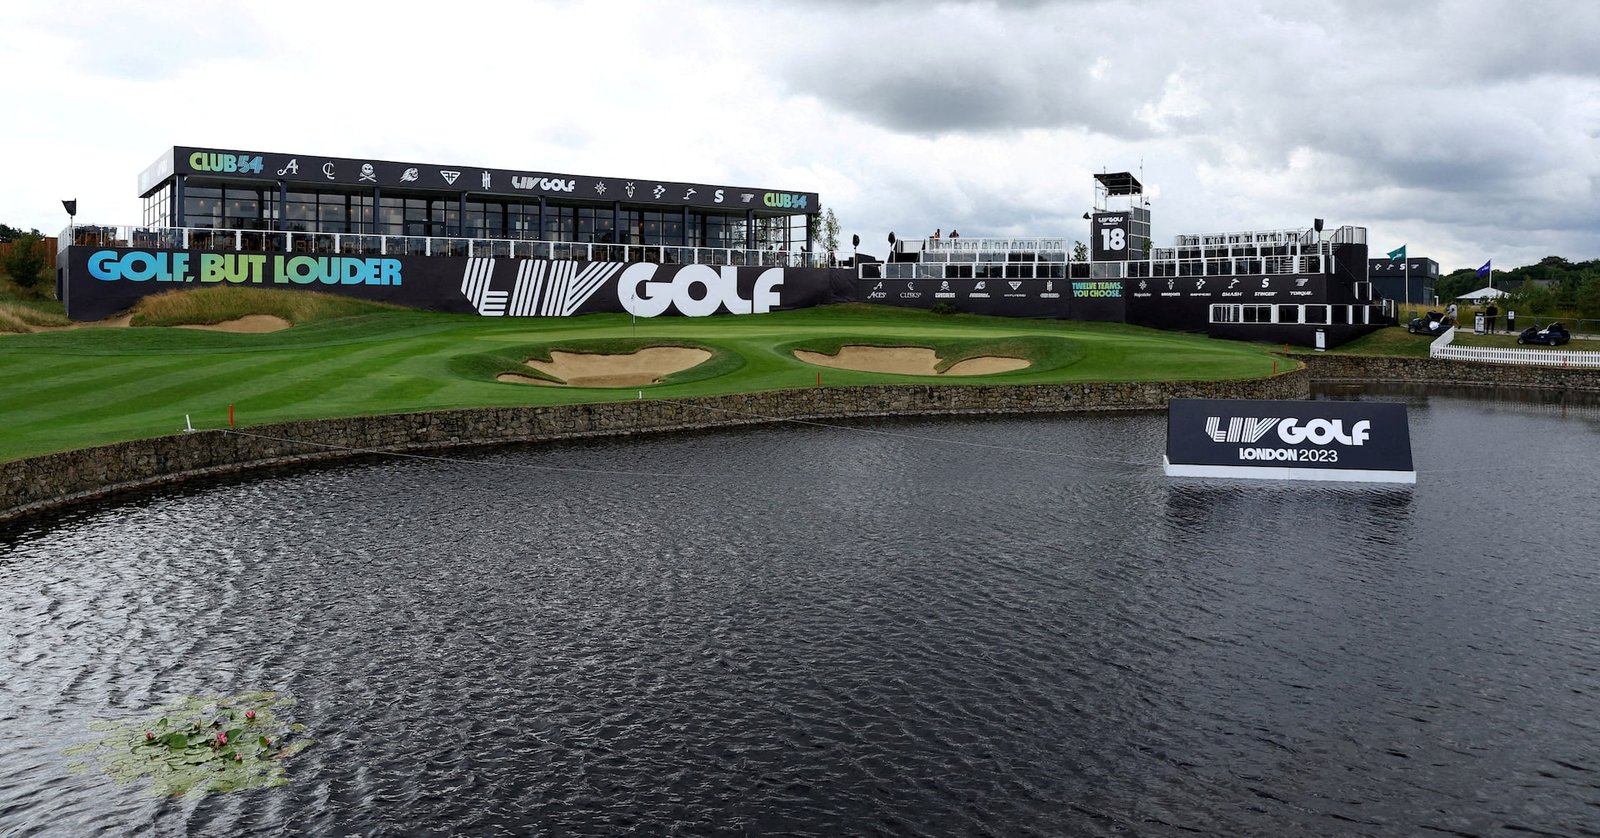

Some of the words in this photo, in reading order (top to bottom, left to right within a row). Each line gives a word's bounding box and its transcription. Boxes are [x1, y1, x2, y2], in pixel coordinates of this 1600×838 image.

[1101, 227, 1126, 251] 18
[87, 250, 195, 283] GOLF,
[200, 253, 266, 284] BUT
[274, 255, 402, 287] LOUDER
[617, 261, 785, 318] GOLF
[1072, 282, 1097, 290] TWELVE
[1097, 281, 1124, 290] TEAMS.
[1073, 289, 1089, 298] YOU
[1089, 289, 1122, 298] CHOOSE.
[1277, 418, 1371, 446] GOLF
[1239, 448, 1297, 461] LONDON
[1299, 449, 1338, 463] 2023
